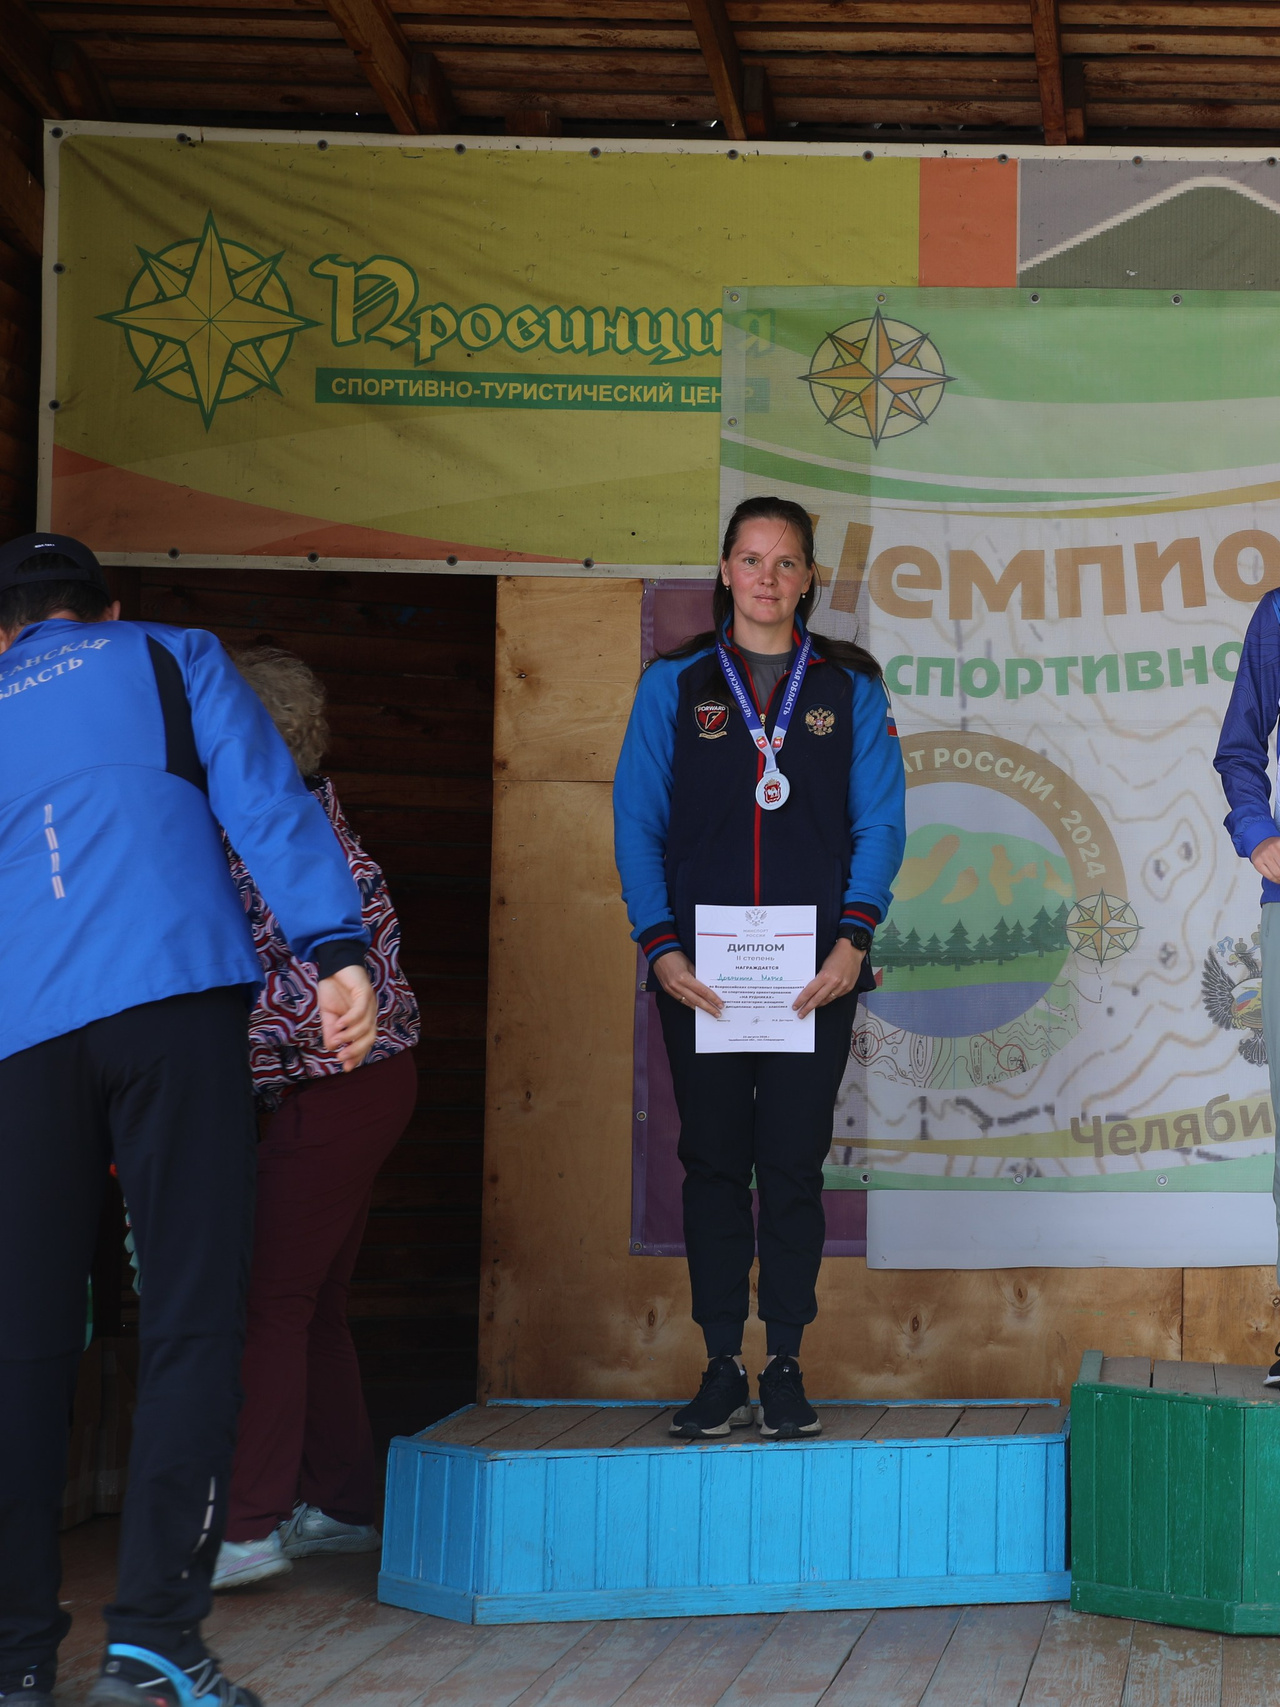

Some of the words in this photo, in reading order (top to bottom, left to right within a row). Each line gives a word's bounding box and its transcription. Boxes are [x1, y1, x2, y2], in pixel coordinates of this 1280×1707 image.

[332, 377, 674, 405] СПОРТИВНО-ТУРИСТИЧЕСКИЙ
[885, 640, 1247, 701] спортивно
[782, 680, 799, 716] ОБЛАСТЬ
[934, 747, 1055, 802] РОССИИ
[1059, 809, 1108, 880] 2024
[727, 943, 785, 952] ДИПЛОМ
